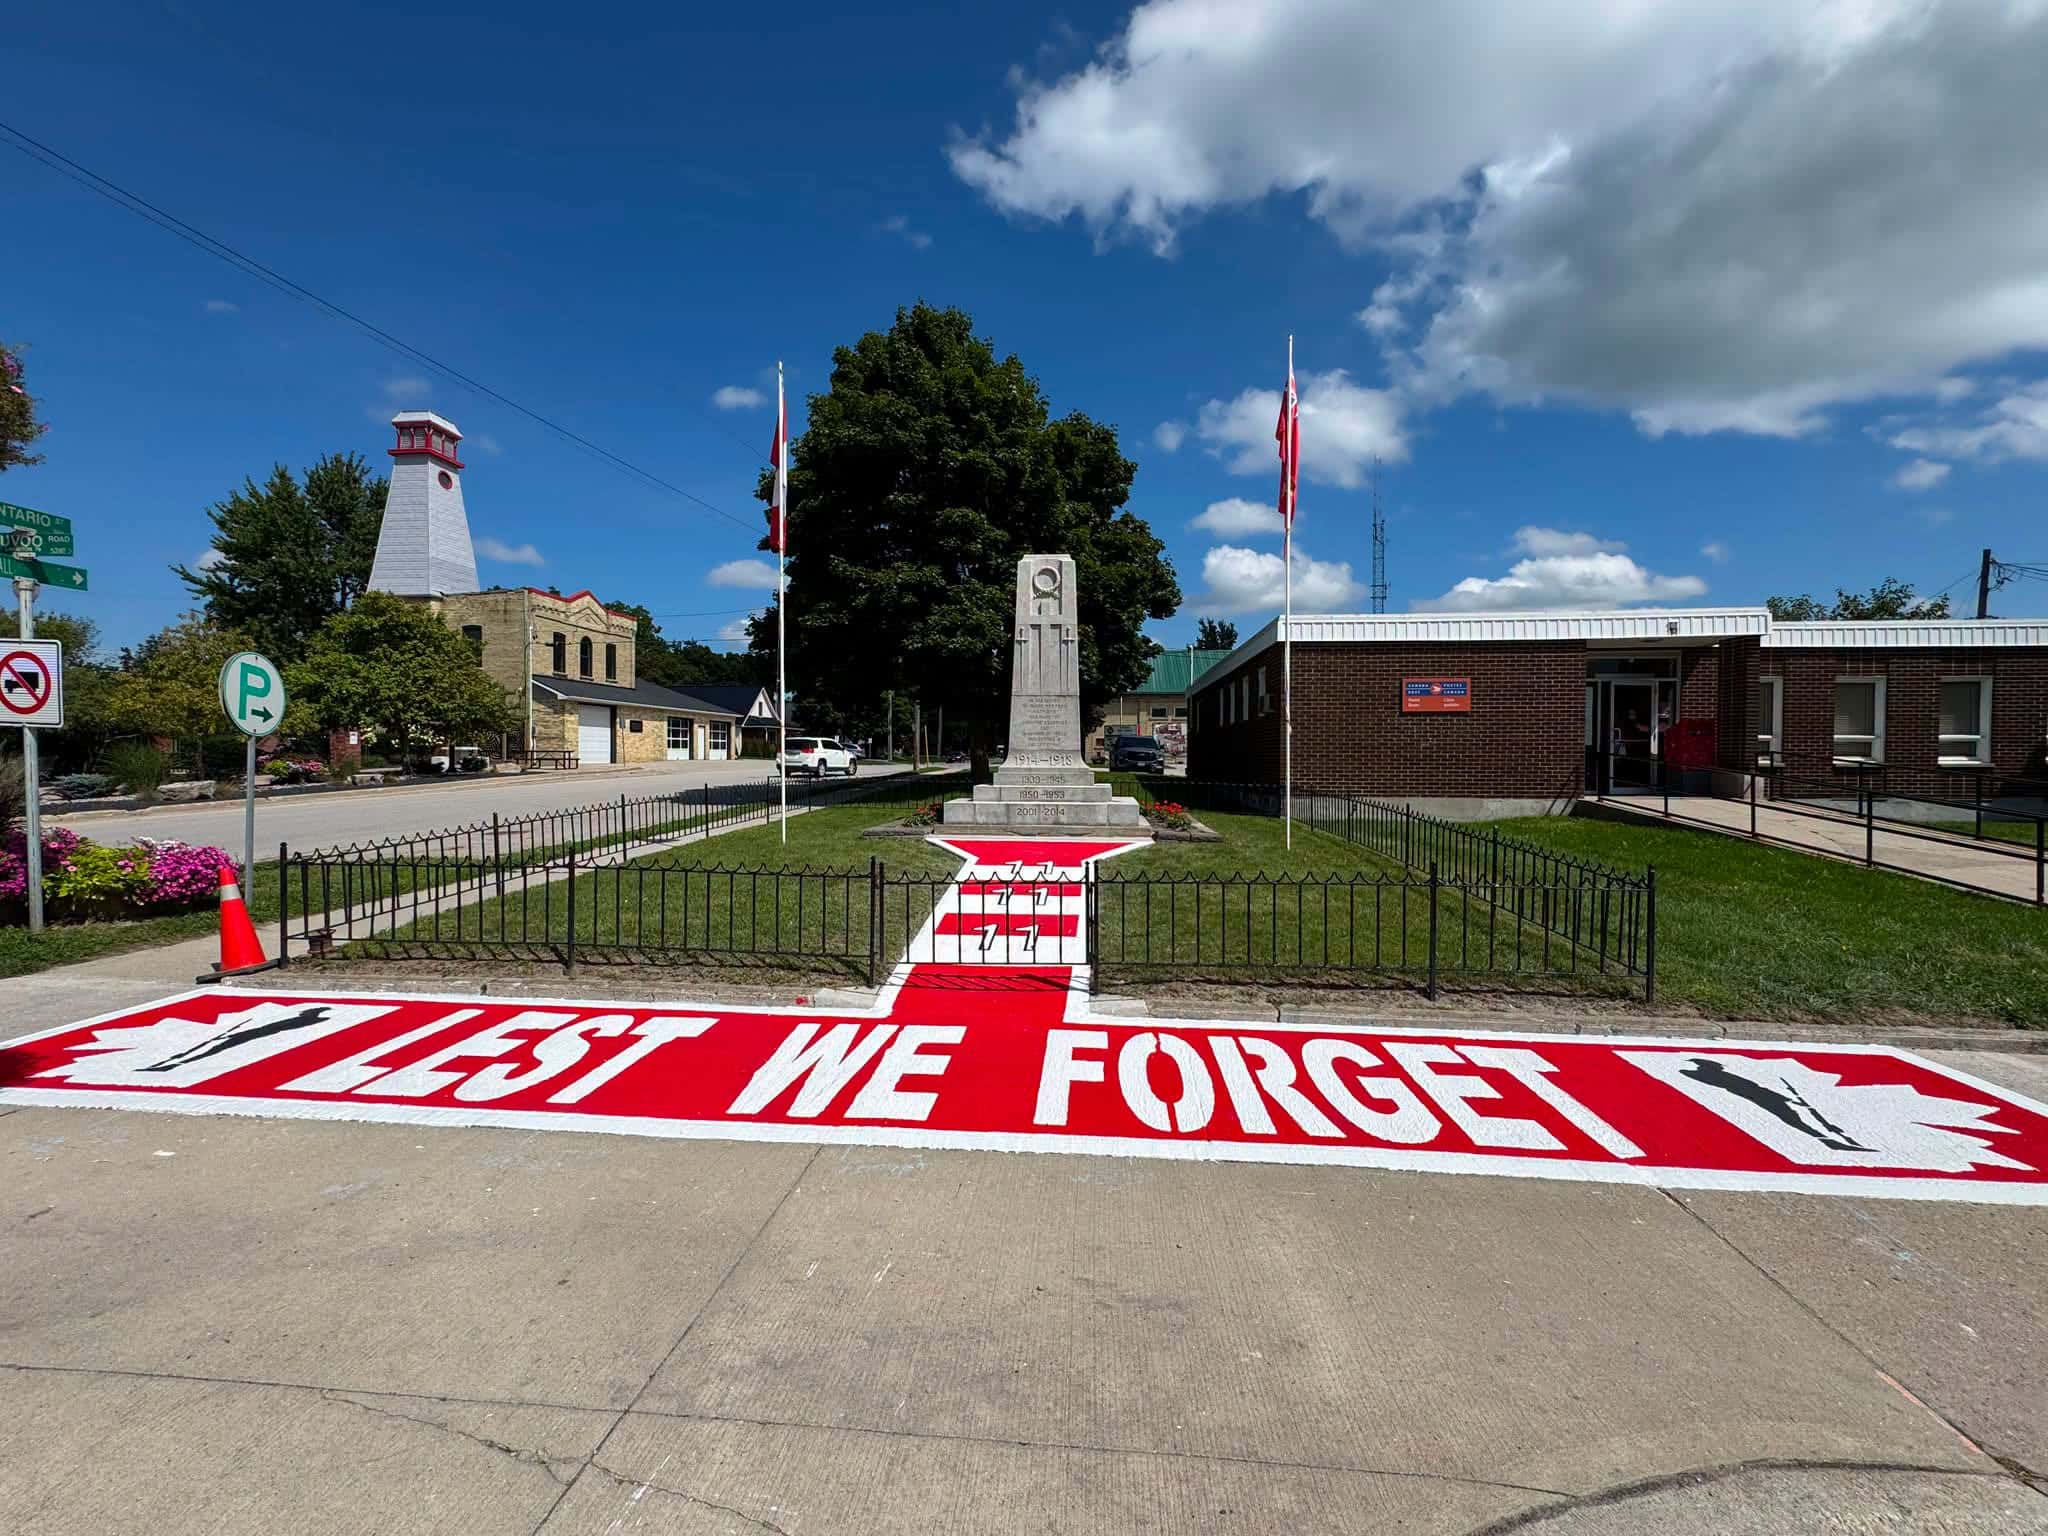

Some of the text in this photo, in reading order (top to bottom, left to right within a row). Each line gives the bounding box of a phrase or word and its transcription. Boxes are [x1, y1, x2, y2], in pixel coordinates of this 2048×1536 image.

[48, 535, 70, 543] ROAD
[238, 662, 271, 720] P
[277, 1008, 1646, 1160] LEST WE FORGET
